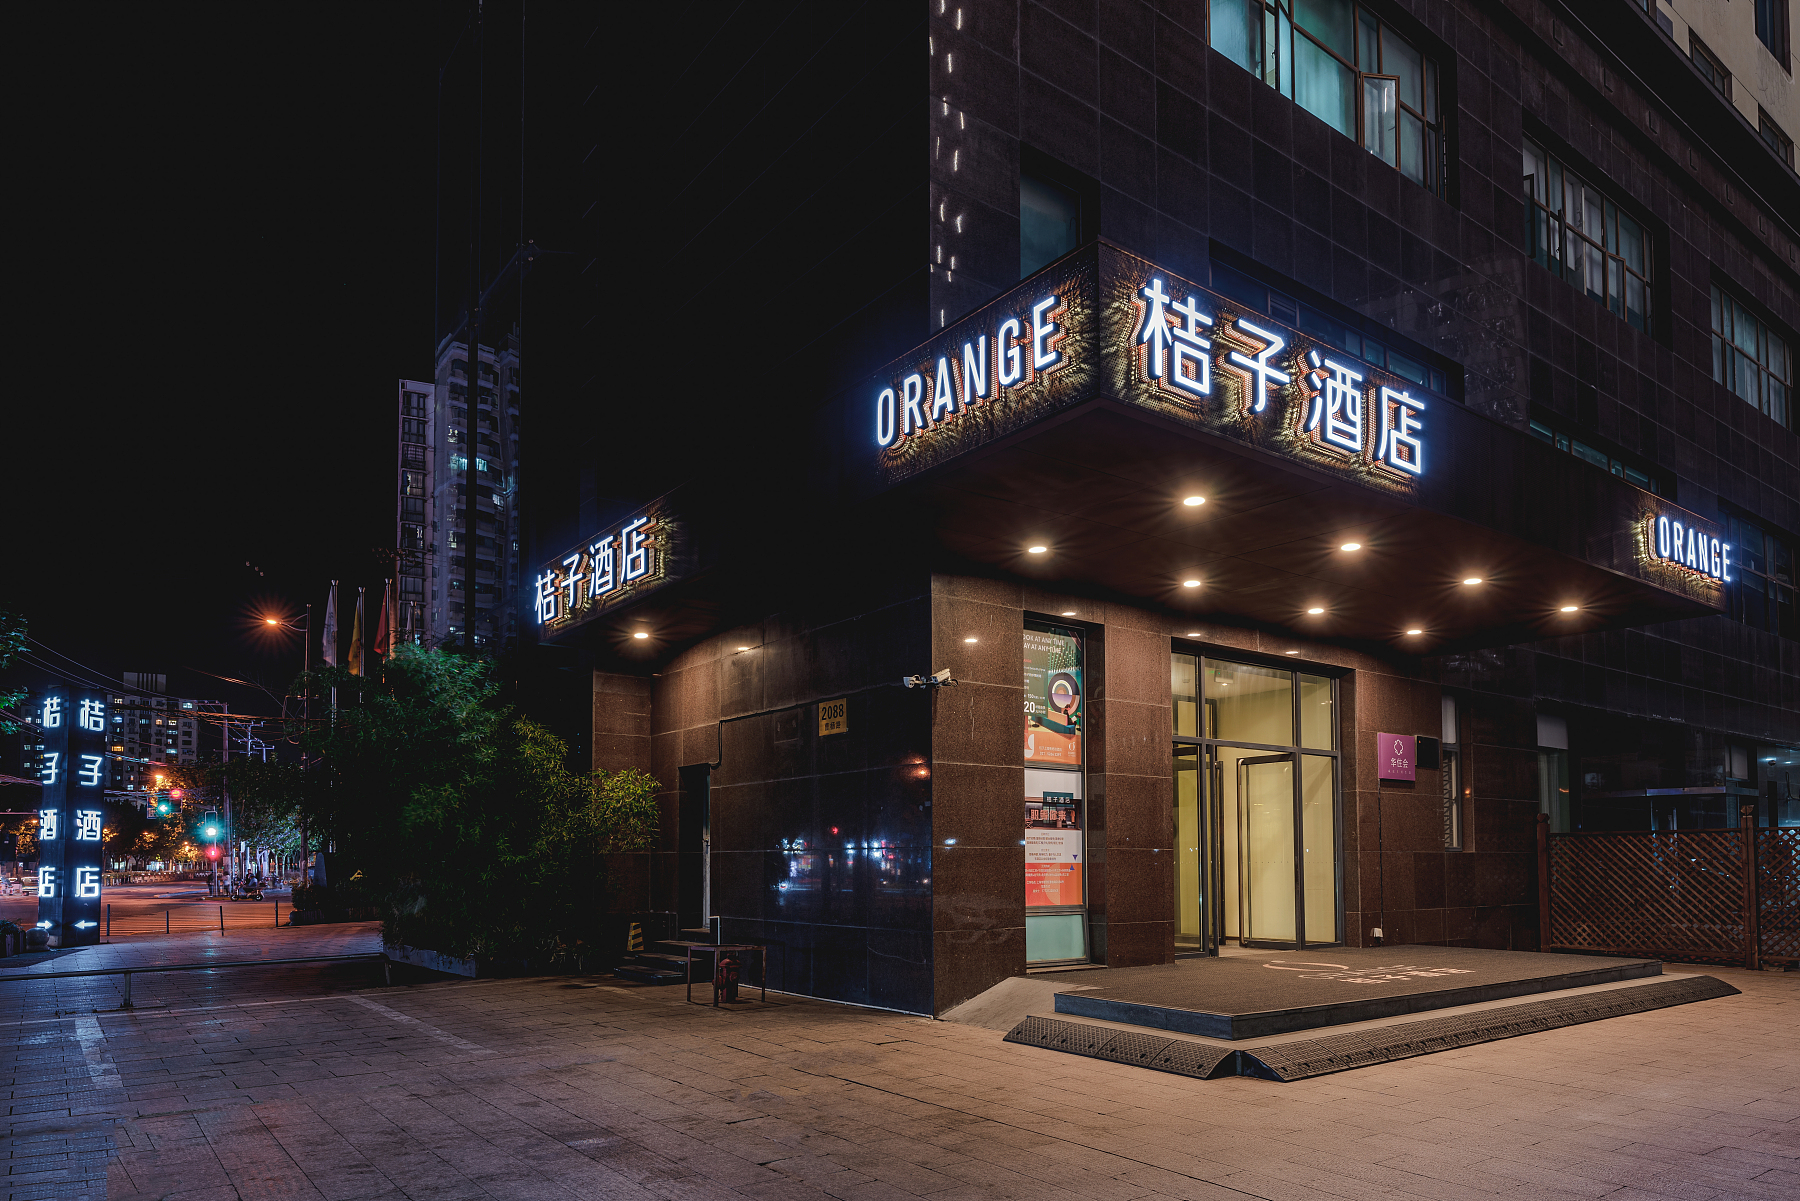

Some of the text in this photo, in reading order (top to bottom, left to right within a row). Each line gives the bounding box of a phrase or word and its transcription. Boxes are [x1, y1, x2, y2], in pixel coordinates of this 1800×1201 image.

[876, 295, 1063, 447] ORANGE
[1138, 278, 1425, 475] 桔子酒店
[535, 516, 648, 624] 桔子酒店
[1659, 516, 1731, 582] ORANGE
[821, 703, 844, 720] 2088
[1390, 757, 1409, 769] 华住会
[38, 696, 60, 898] 桔子酒店
[75, 698, 105, 898] 桔子酒店
